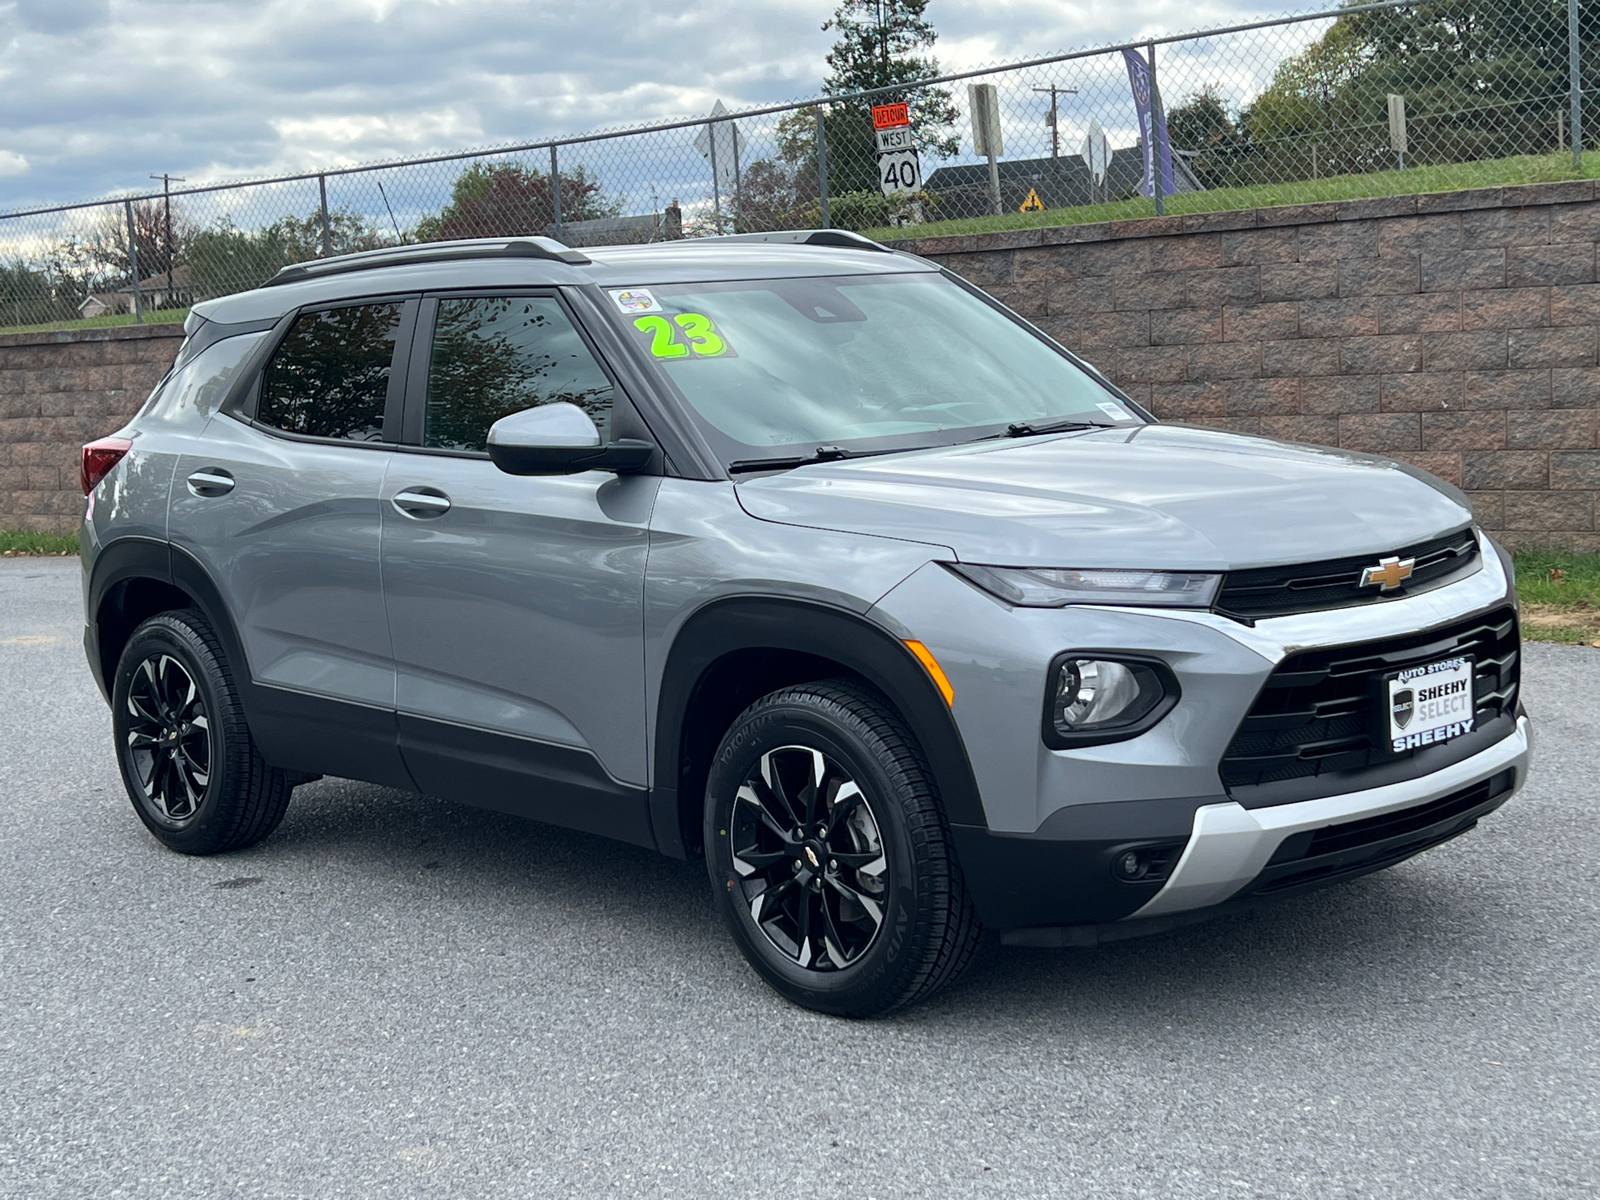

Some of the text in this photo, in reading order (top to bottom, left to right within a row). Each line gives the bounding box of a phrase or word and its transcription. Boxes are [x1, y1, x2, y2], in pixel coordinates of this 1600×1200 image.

[876, 108, 905, 124] DETOUR
[880, 131, 907, 147] WEST
[884, 160, 916, 189] 40
[633, 312, 728, 359] 23
[1397, 657, 1465, 681] AUTO STORES
[1418, 678, 1467, 702] SHEEHY
[1419, 694, 1467, 721] SELECT
[720, 713, 774, 765] YOKOHAMA
[1393, 719, 1474, 753] SHEEHY
